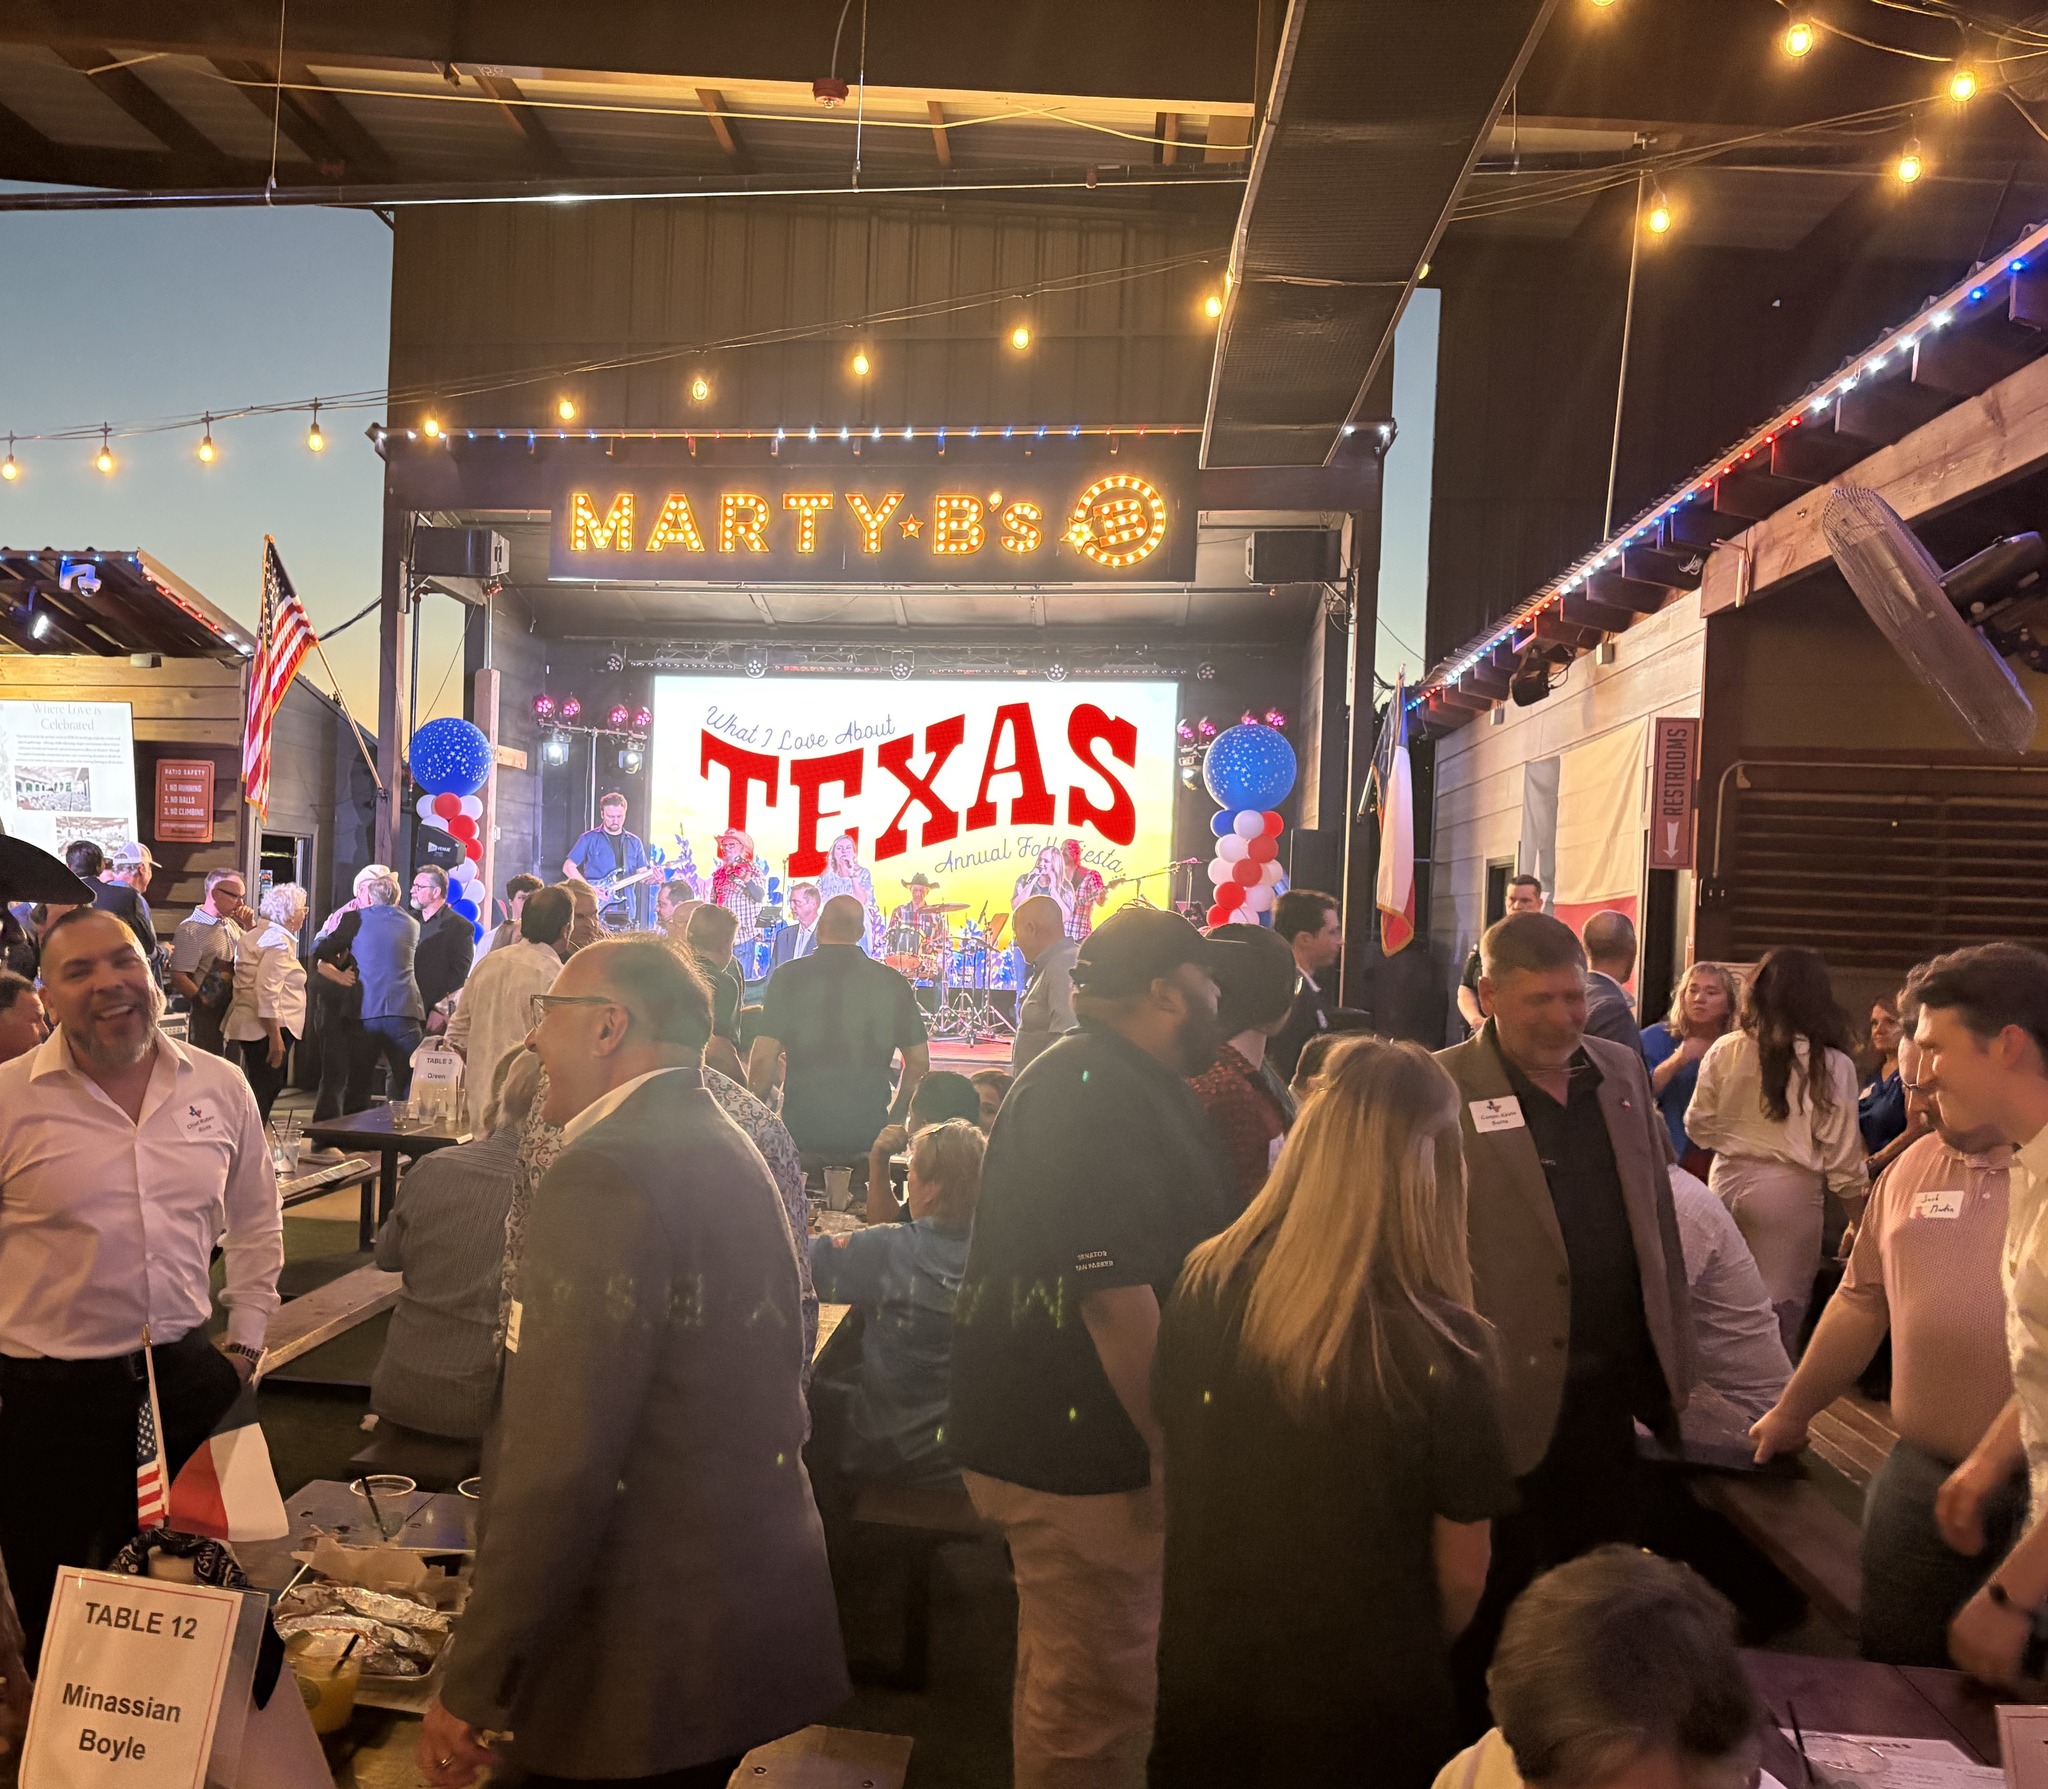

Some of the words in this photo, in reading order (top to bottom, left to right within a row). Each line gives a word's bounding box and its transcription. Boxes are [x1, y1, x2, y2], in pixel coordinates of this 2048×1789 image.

[570, 493, 905, 553] MARTY
[933, 492, 1043, 554] B's
[32, 703, 64, 715] Where
[67, 703, 91, 716] Love
[93, 703, 102, 715] is
[40, 718, 95, 731] Celebrated
[706, 705, 758, 743] What
[761, 728, 773, 747] I
[777, 730, 828, 750] Love
[835, 713, 896, 743] About
[169, 783, 177, 792] NO
[178, 784, 202, 792] RUNNING
[1663, 728, 1687, 816] RESTROOMS
[170, 796, 178, 804] NO
[179, 796, 195, 804] BALLS
[700, 702, 1138, 877] TEXAS
[170, 807, 178, 816] NO
[178, 808, 204, 816] CLIMBING
[934, 838, 1012, 873] Annual
[1077, 1250, 1108, 1261] SENATOR
[1088, 1260, 1114, 1269] PARKER
[85, 1602, 164, 1634] TABLE
[171, 1616, 198, 1639] 12
[61, 1682, 182, 1723] Minassian
[78, 1728, 146, 1762] Boyle
